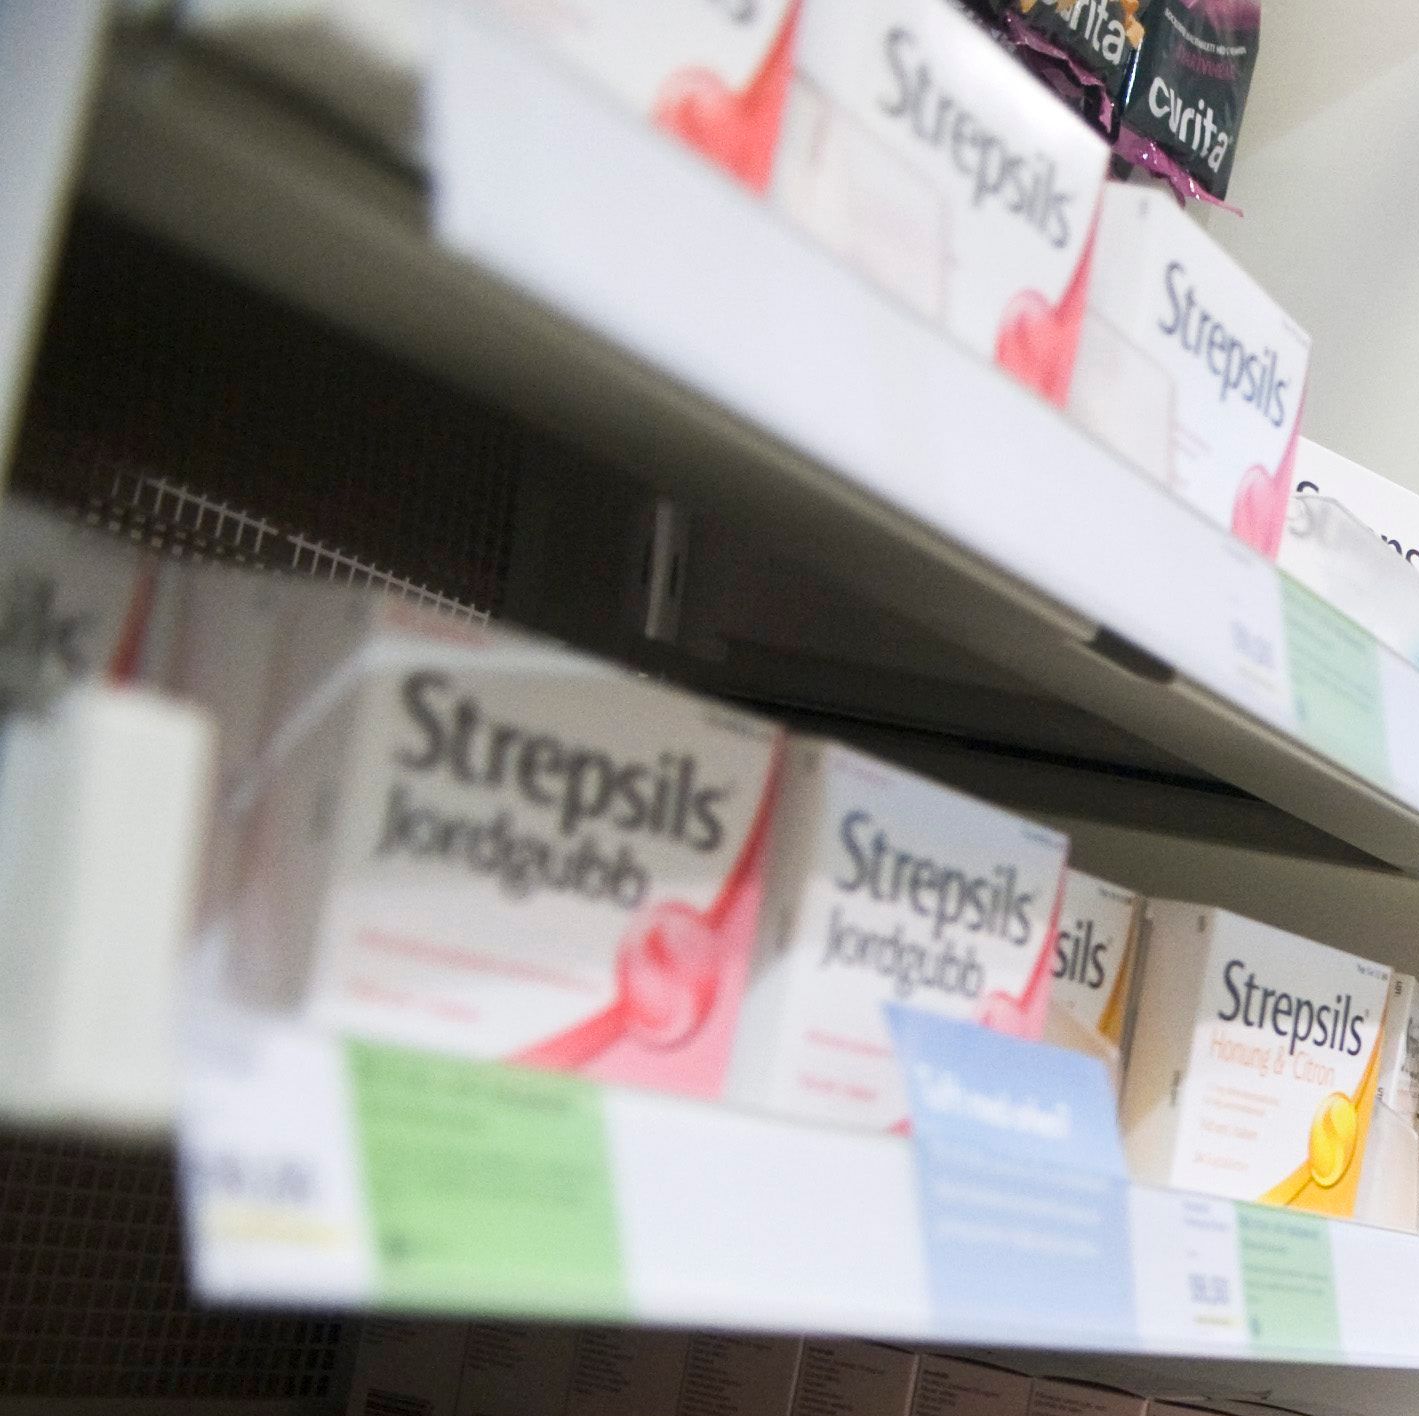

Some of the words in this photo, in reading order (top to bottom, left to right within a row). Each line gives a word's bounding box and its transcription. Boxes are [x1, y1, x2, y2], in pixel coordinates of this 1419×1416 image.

[878, 24, 1073, 250] Strepsils
[1148, 76, 1229, 174] curita
[1156, 260, 1288, 431] Strepsils
[394, 669, 726, 853] Strepsils
[372, 785, 650, 910] Jordgubb
[836, 809, 1035, 946] Strepsils
[821, 906, 986, 1000] Jordgubb
[1051, 919, 1108, 990] sils
[1217, 959, 1366, 1057] Strepsils
[1210, 1030, 1270, 1077] Honung
[1291, 1050, 1336, 1086] Citron
